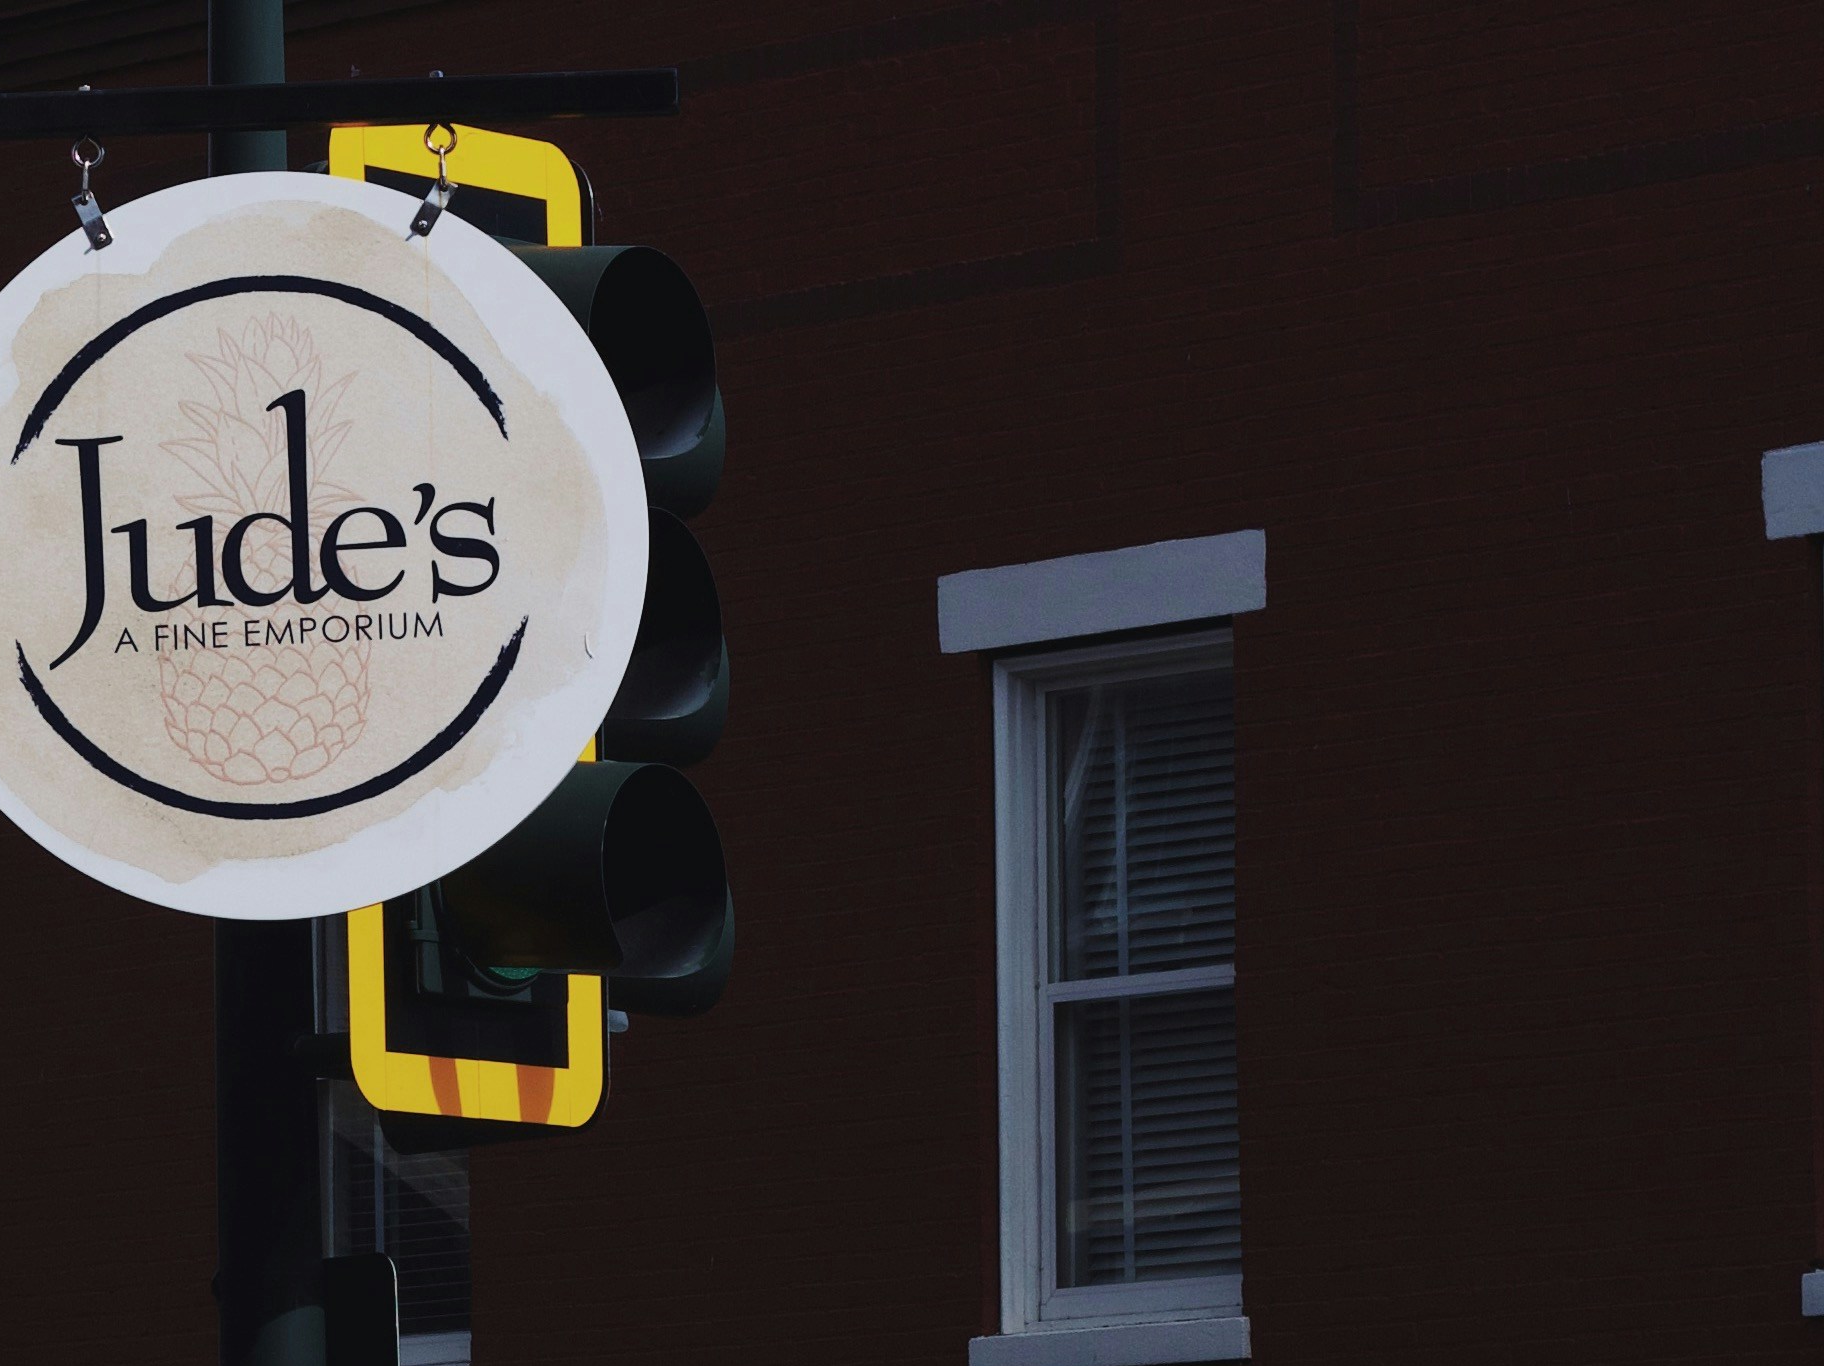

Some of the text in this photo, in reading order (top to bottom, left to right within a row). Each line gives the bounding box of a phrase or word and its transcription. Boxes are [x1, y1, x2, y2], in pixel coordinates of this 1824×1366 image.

[49, 389, 500, 670] Jude's
[114, 612, 445, 654] A FINE EMPORIUM
